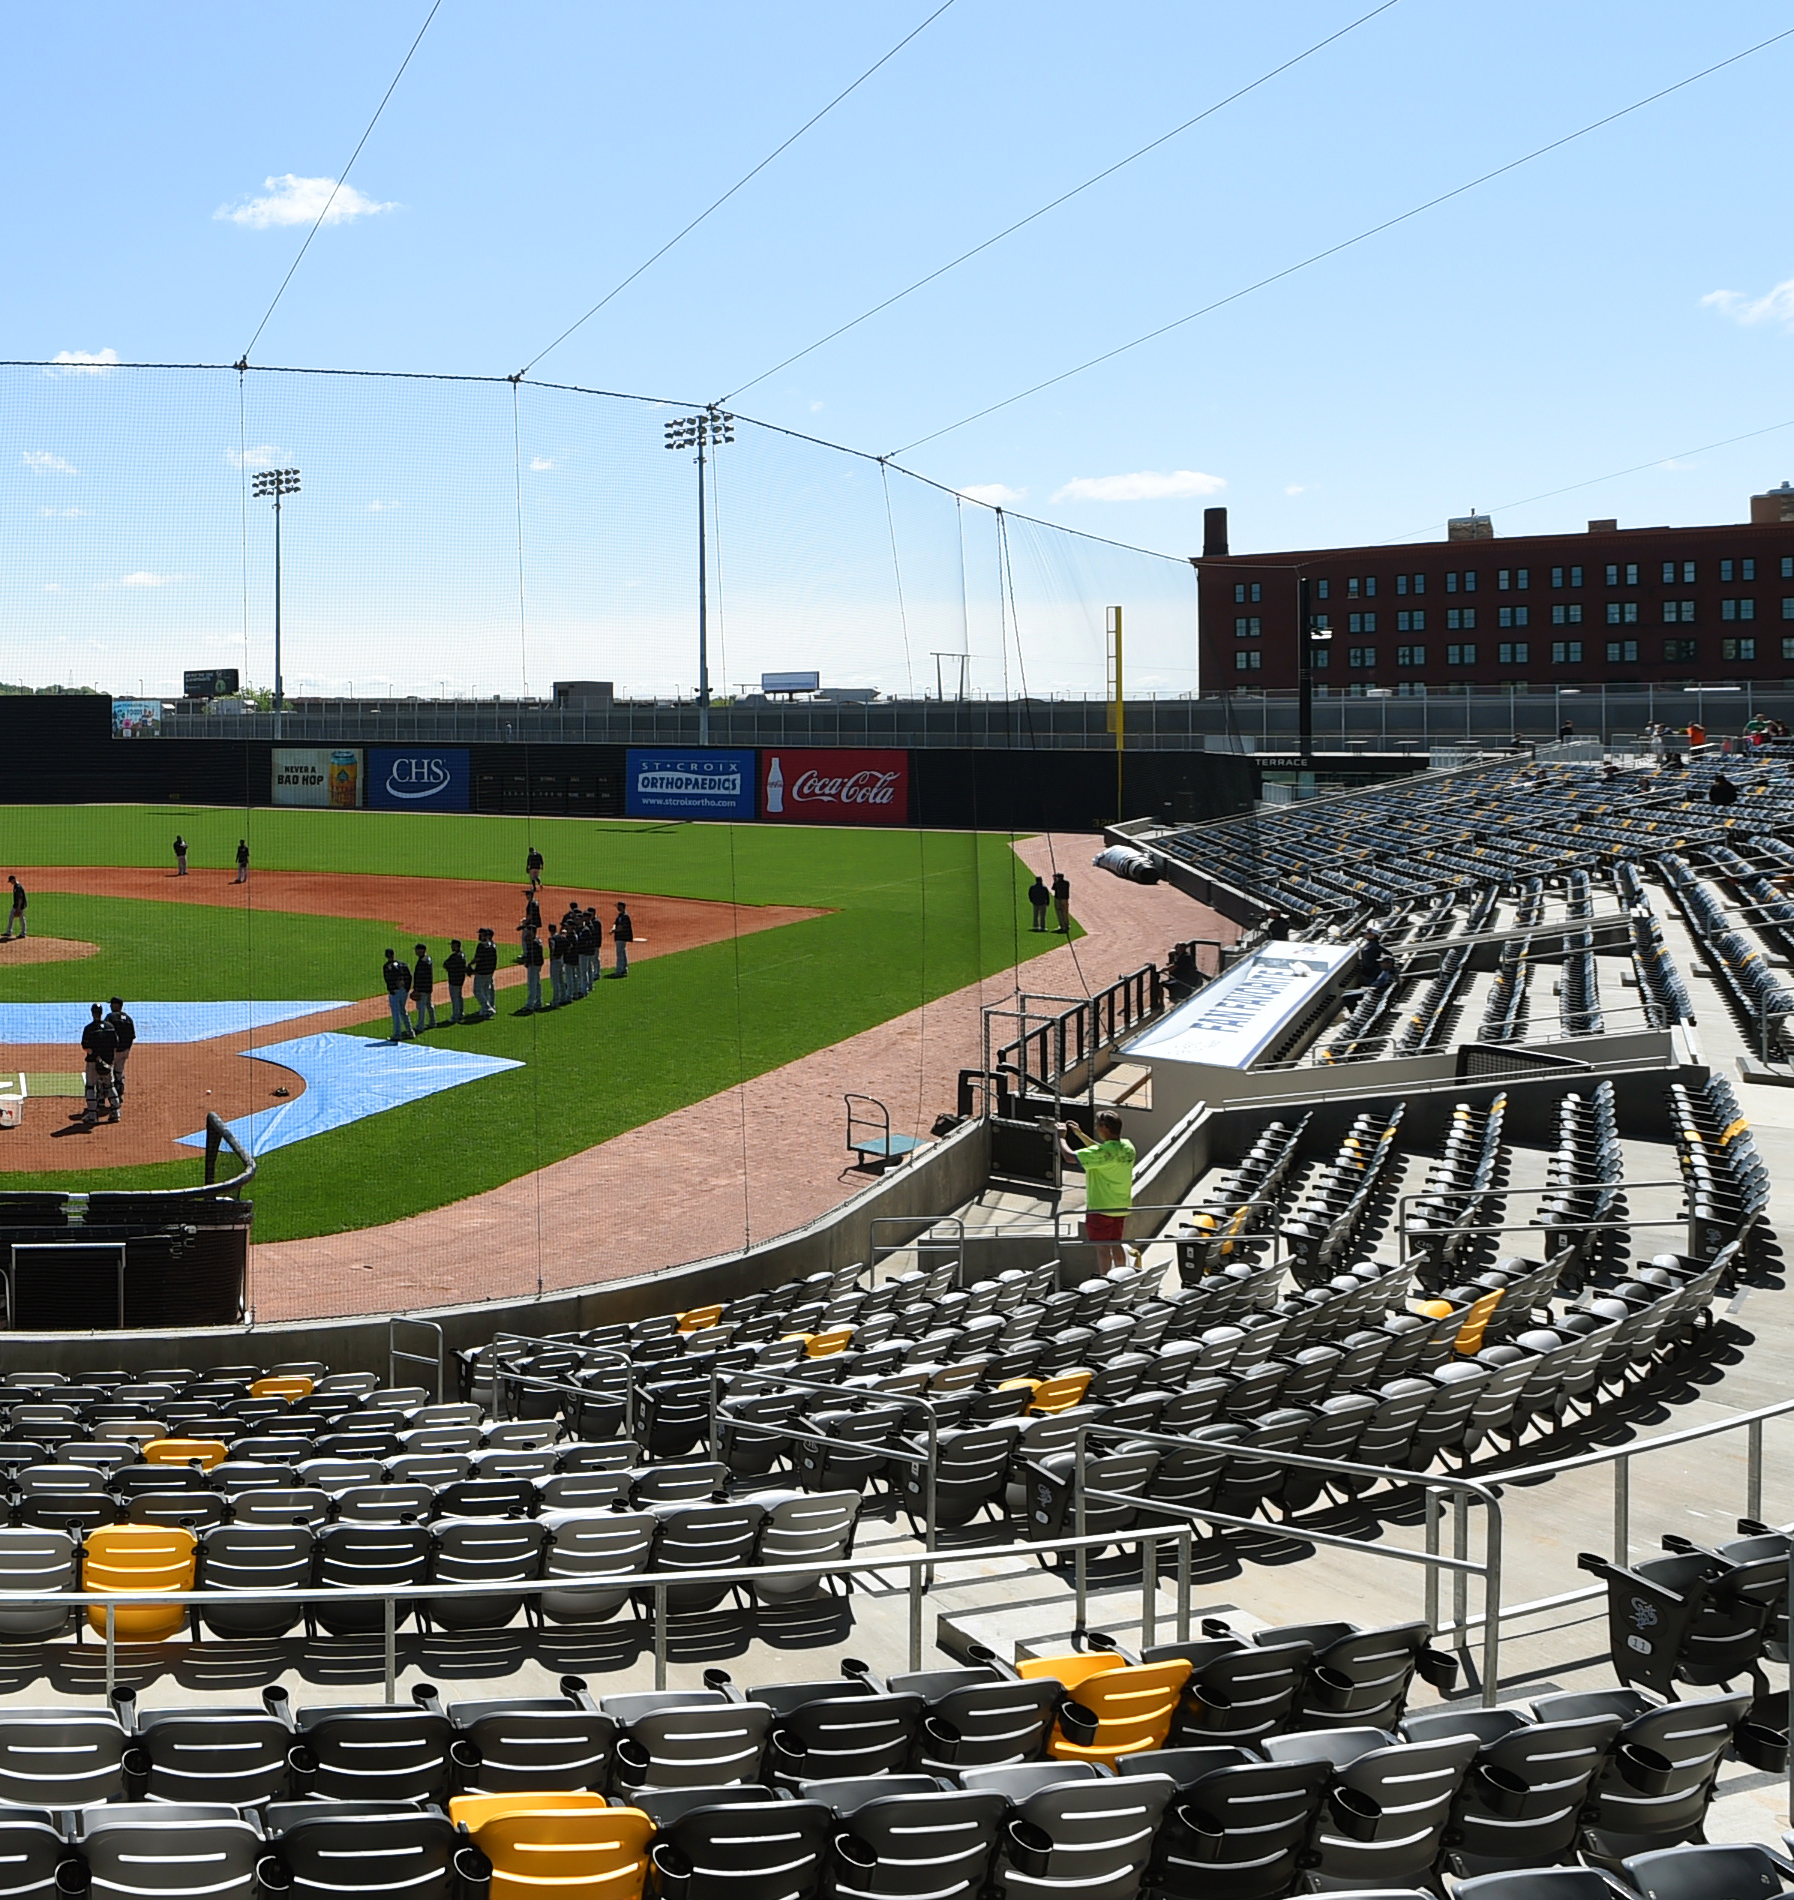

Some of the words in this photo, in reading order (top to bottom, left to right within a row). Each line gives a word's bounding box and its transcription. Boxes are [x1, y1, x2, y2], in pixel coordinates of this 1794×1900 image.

[641, 762, 662, 771] ST
[676, 762, 738, 772] CROIX
[1256, 758, 1308, 767] TERRACE
[284, 765, 309, 774] NEVER
[310, 766, 316, 774] A
[392, 758, 444, 783] CHS
[277, 774, 299, 785] BAD
[302, 774, 324, 786] HOP
[641, 776, 737, 791] ORTHOPAEDICS
[792, 769, 901, 804] Coca-Cola
[641, 797, 736, 808] www.stcroixortho.com
[1215, 969, 1300, 1011] FAVORITE
[1189, 1009, 1256, 1033] FAN
